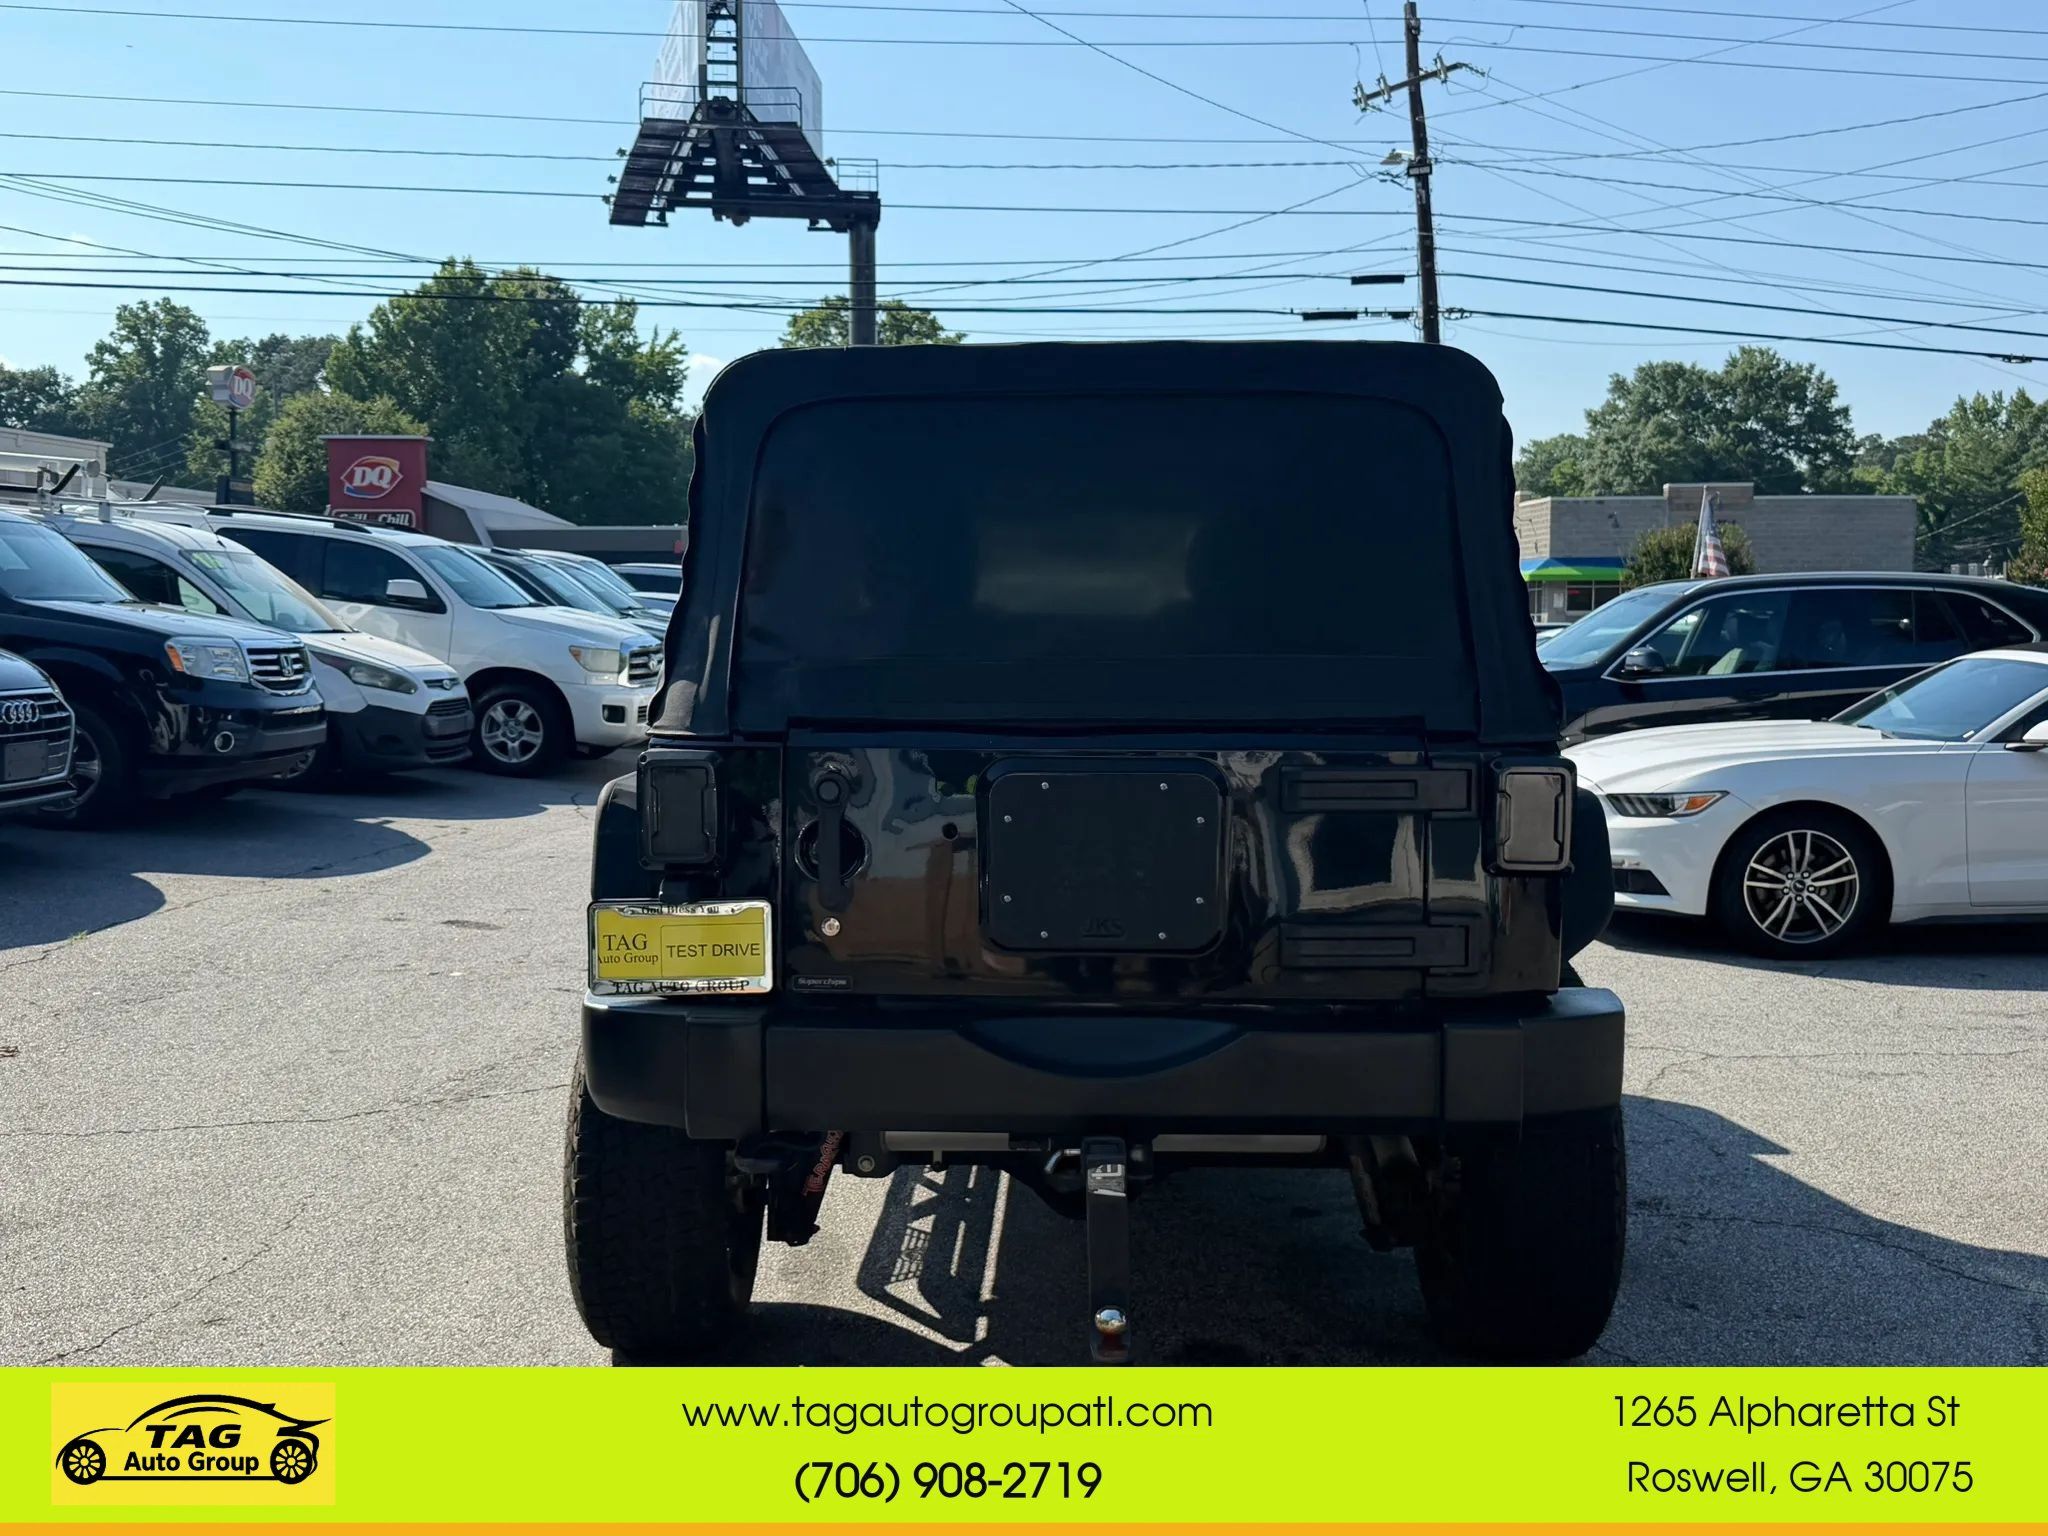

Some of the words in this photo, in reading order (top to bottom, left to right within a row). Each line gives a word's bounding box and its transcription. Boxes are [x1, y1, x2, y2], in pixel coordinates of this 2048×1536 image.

[234, 374, 251, 398] DQ
[352, 465, 393, 488] DQ
[378, 513, 410, 526] Chill
[667, 904, 697, 914] Bless
[602, 933, 648, 951] TAG
[666, 944, 708, 958] TEST
[711, 943, 761, 957] DRIVE
[623, 952, 659, 966] Group
[612, 981, 644, 994] TAG
[651, 981, 690, 993] AUTO
[694, 979, 750, 993] GROUP
